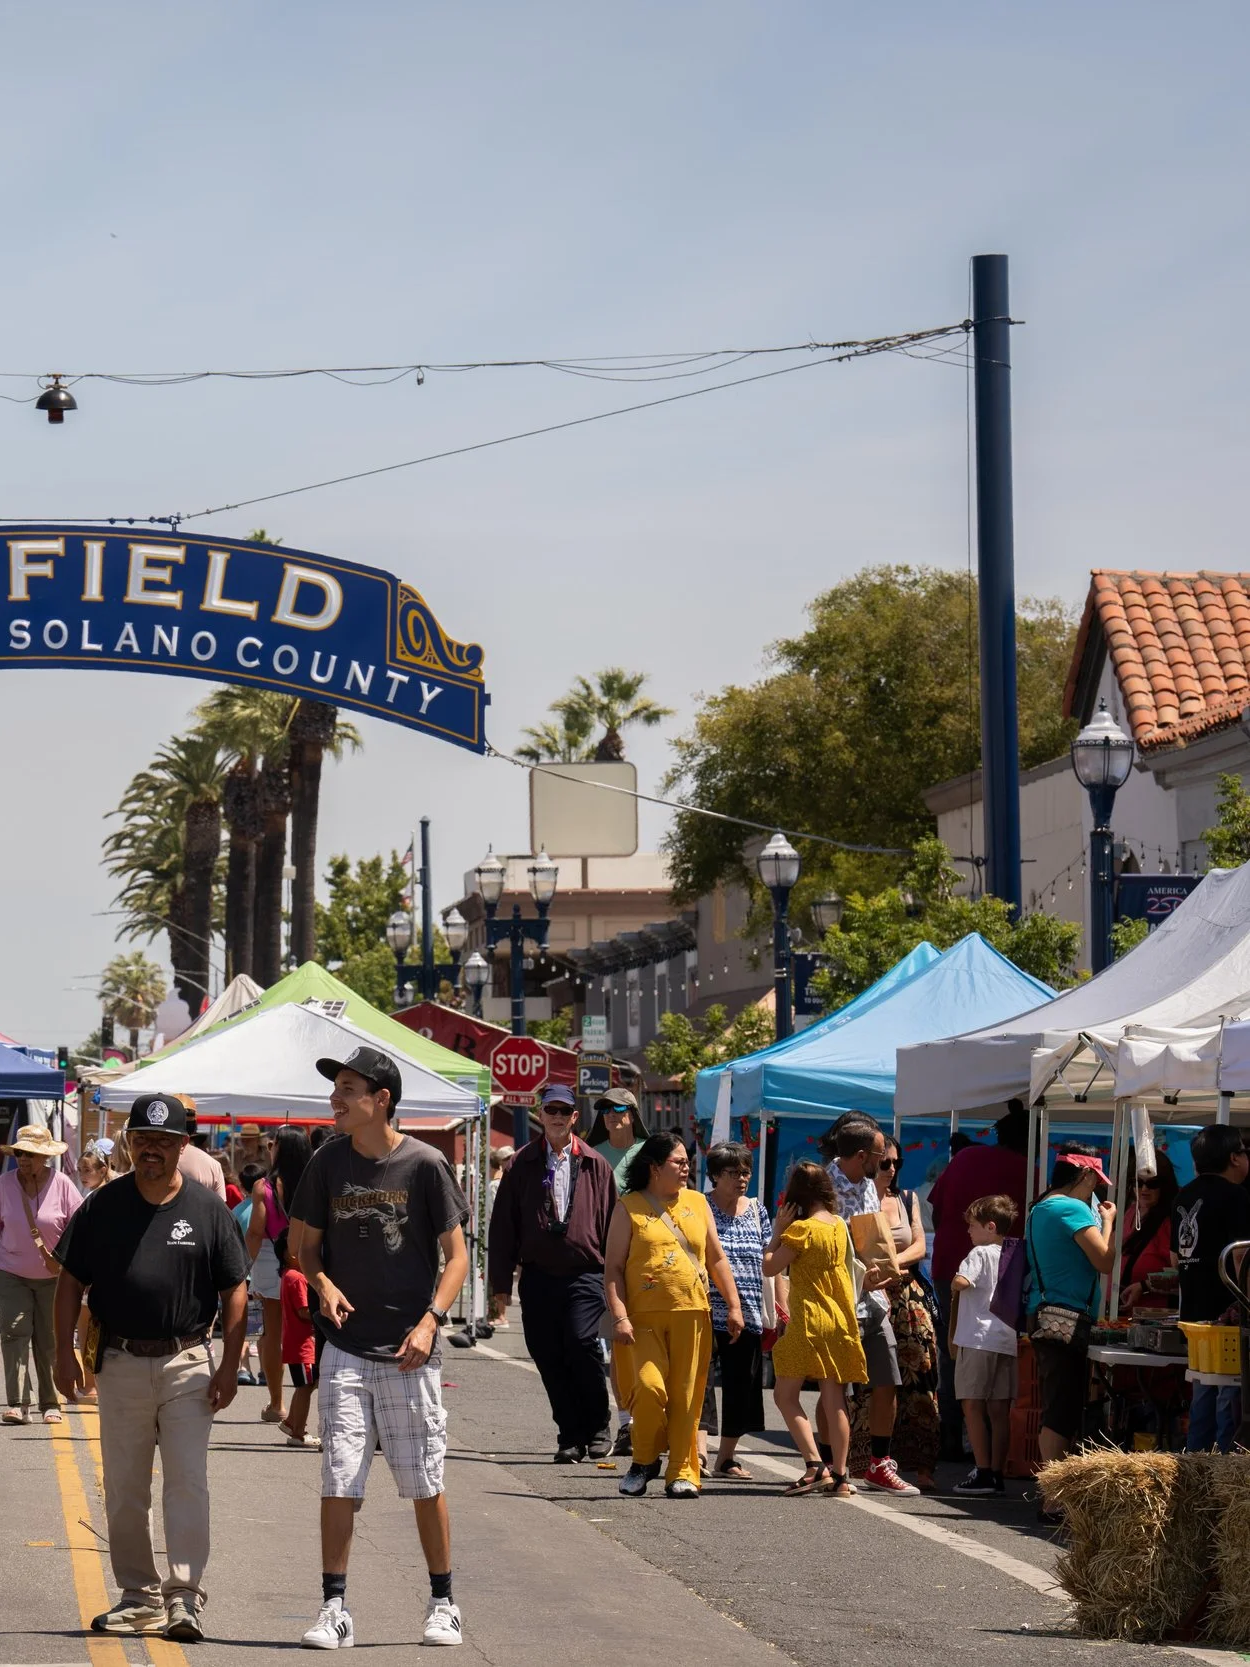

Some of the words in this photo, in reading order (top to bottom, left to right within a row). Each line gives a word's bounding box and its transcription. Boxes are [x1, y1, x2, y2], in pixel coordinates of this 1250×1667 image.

[8, 618, 218, 662] SOLANO
[236, 636, 444, 715] COUNTY
[1147, 886, 1188, 895] AMERICA
[494, 1053, 545, 1077] STOP
[579, 1068, 610, 1088] Parking
[505, 1095, 518, 1104] ALL
[519, 1095, 534, 1104] WAY
[332, 1189, 409, 1212] BUCKHORN
